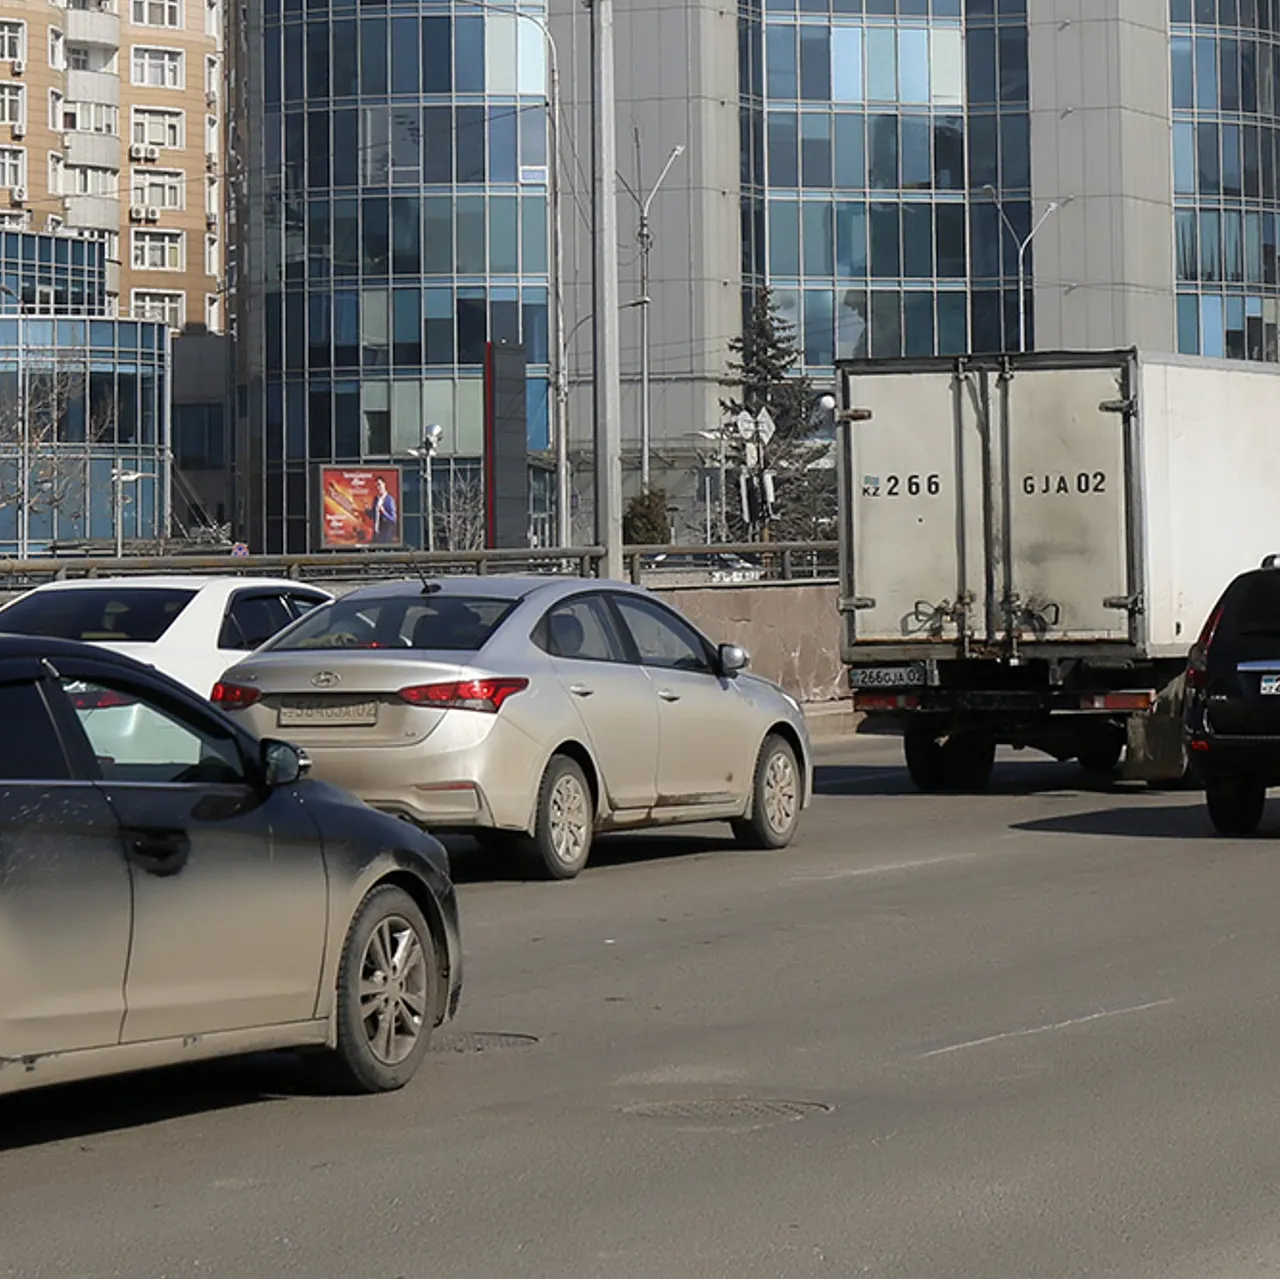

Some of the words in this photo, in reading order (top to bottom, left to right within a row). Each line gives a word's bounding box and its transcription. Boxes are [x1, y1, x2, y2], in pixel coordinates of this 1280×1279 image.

[862, 486, 881, 497] KZ
[886, 474, 940, 496] 266
[1022, 475, 1069, 495] GJA
[1076, 471, 1106, 494] 02
